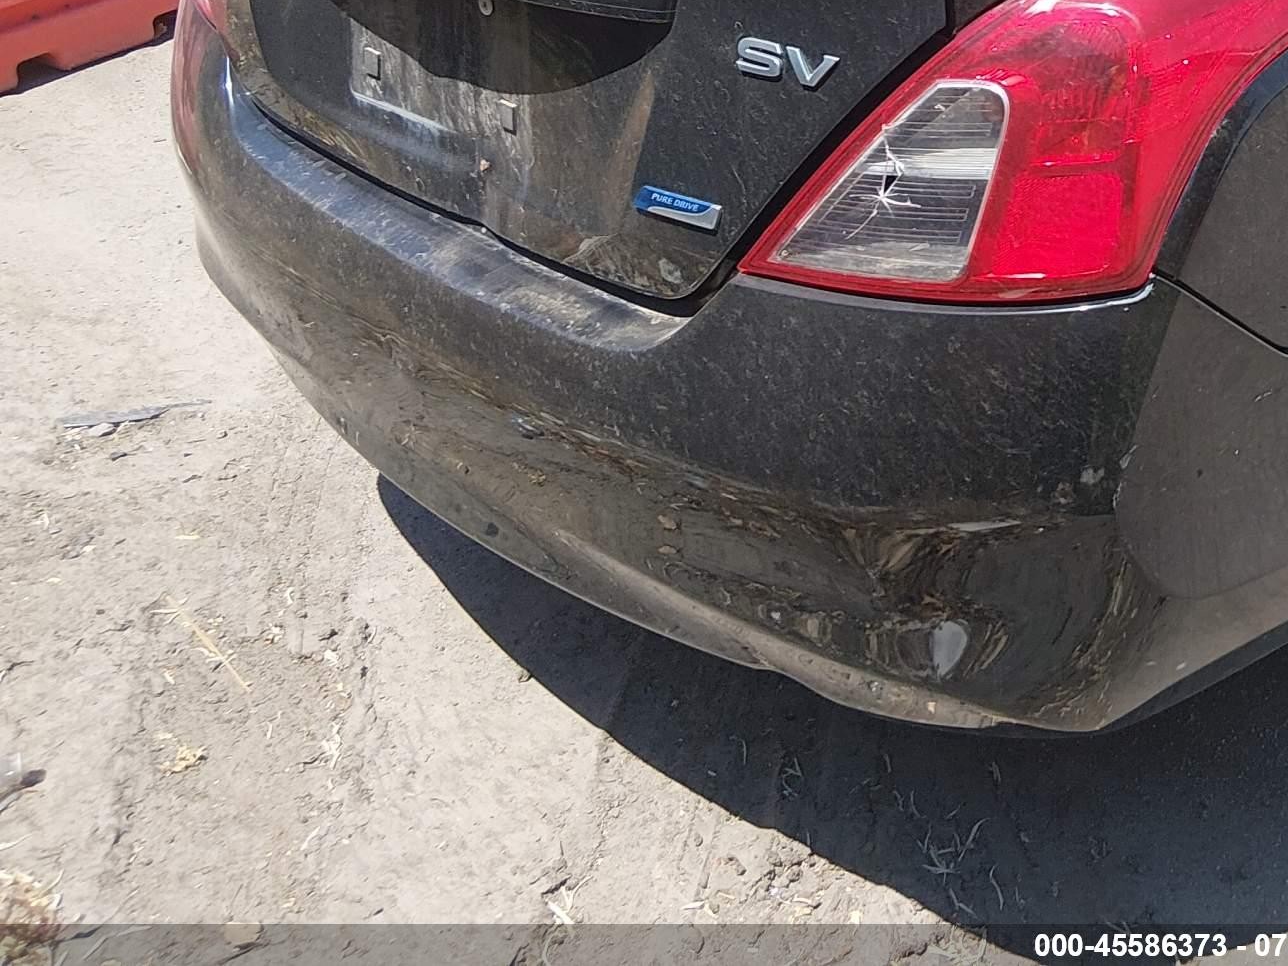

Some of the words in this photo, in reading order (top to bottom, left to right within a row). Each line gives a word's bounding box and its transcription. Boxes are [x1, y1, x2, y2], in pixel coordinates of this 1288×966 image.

[736, 37, 840, 87] SV
[651, 192, 674, 206] PURE
[673, 199, 700, 212] DRIVE
